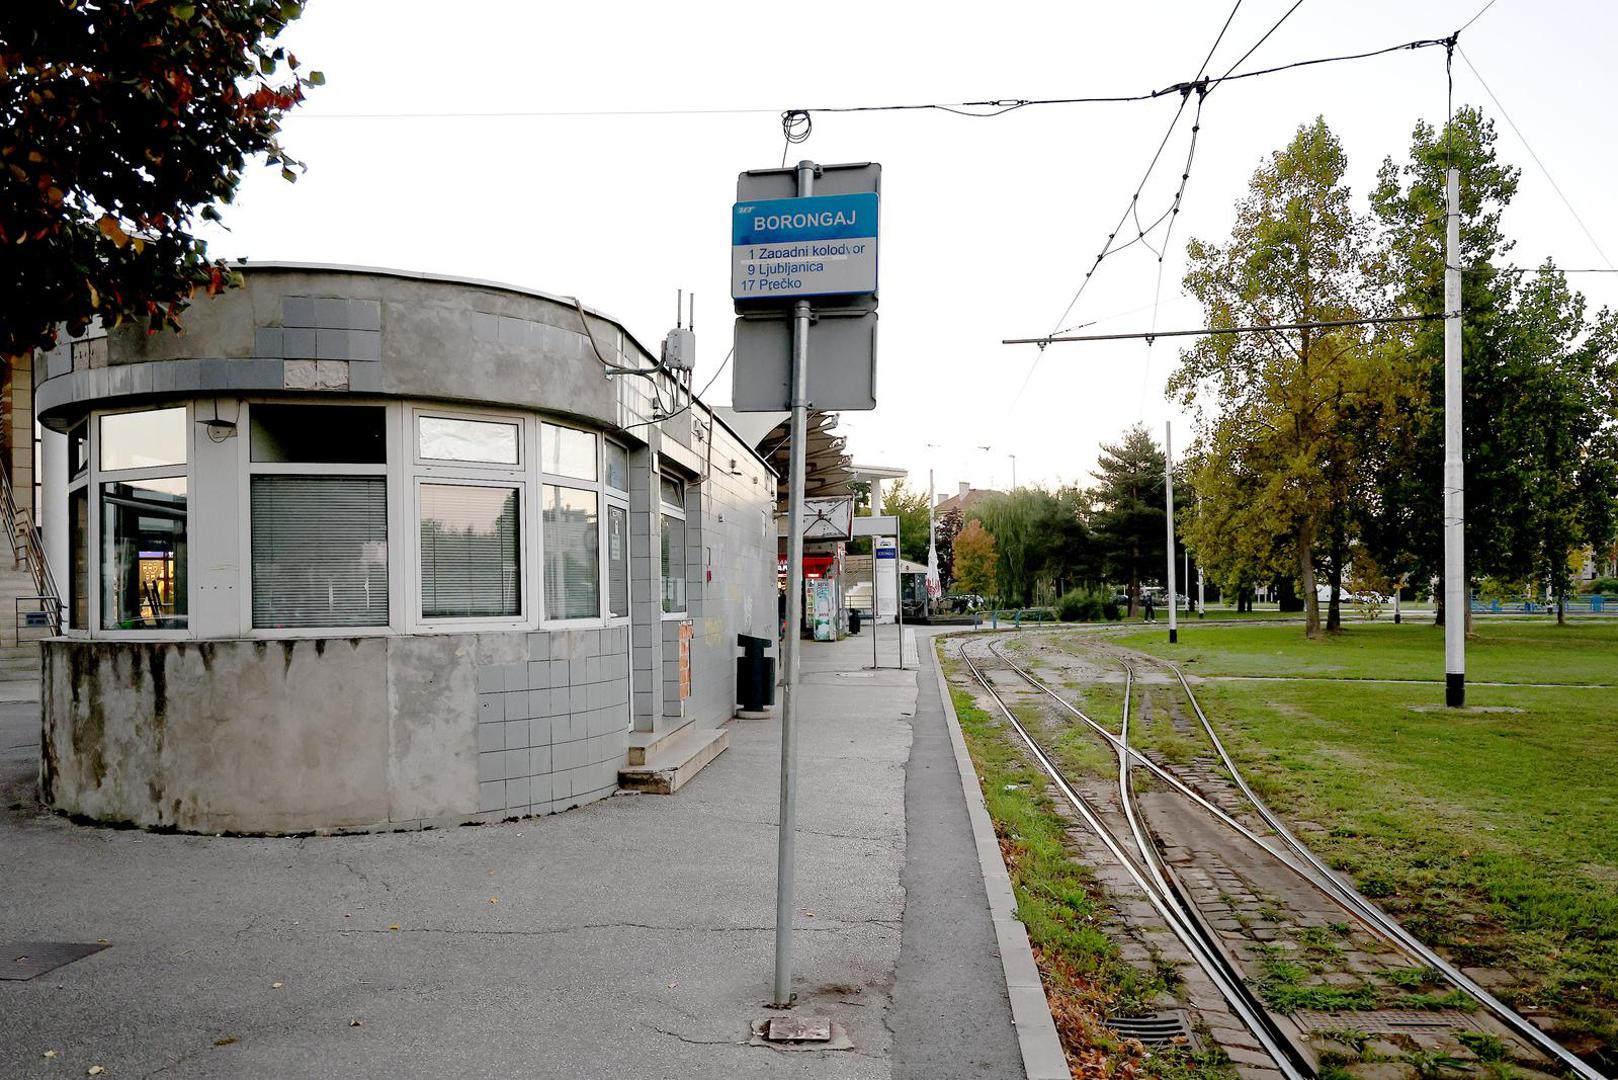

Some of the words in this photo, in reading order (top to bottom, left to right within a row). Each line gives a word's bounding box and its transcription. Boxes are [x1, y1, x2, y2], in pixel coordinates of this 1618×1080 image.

[754, 210, 856, 231] BORONGAJ
[749, 250, 754, 260] 1
[759, 246, 809, 260] Zapadni
[748, 264, 755, 276] 9
[759, 261, 824, 278] Ljubljanica
[741, 279, 755, 291] 17
[759, 277, 802, 291] Prečko
